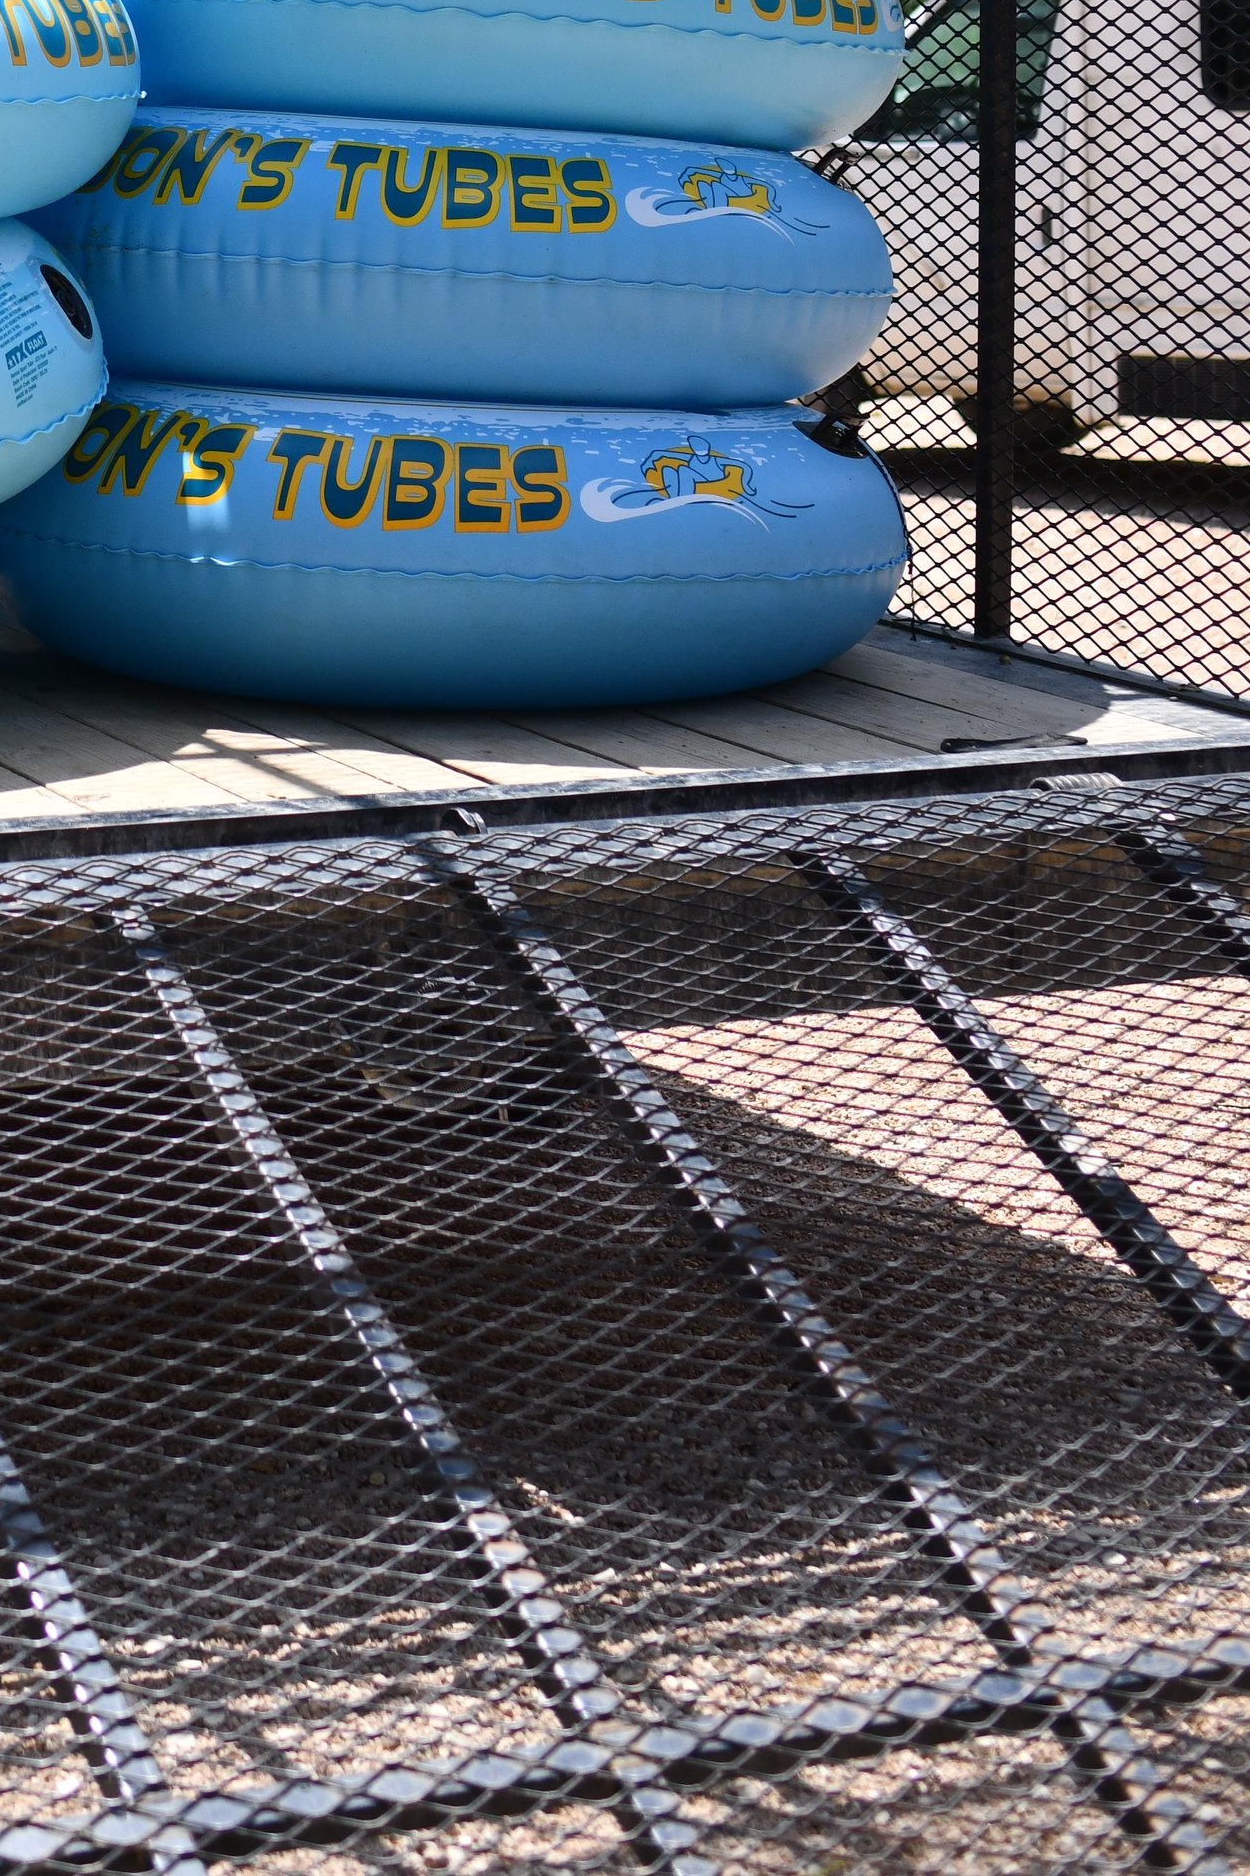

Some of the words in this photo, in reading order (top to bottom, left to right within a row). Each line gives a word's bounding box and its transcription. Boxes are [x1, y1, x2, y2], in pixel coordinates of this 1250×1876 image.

[325, 140, 617, 234] TUBES
[63, 402, 260, 506] ON'S
[266, 427, 572, 534] TUBES
